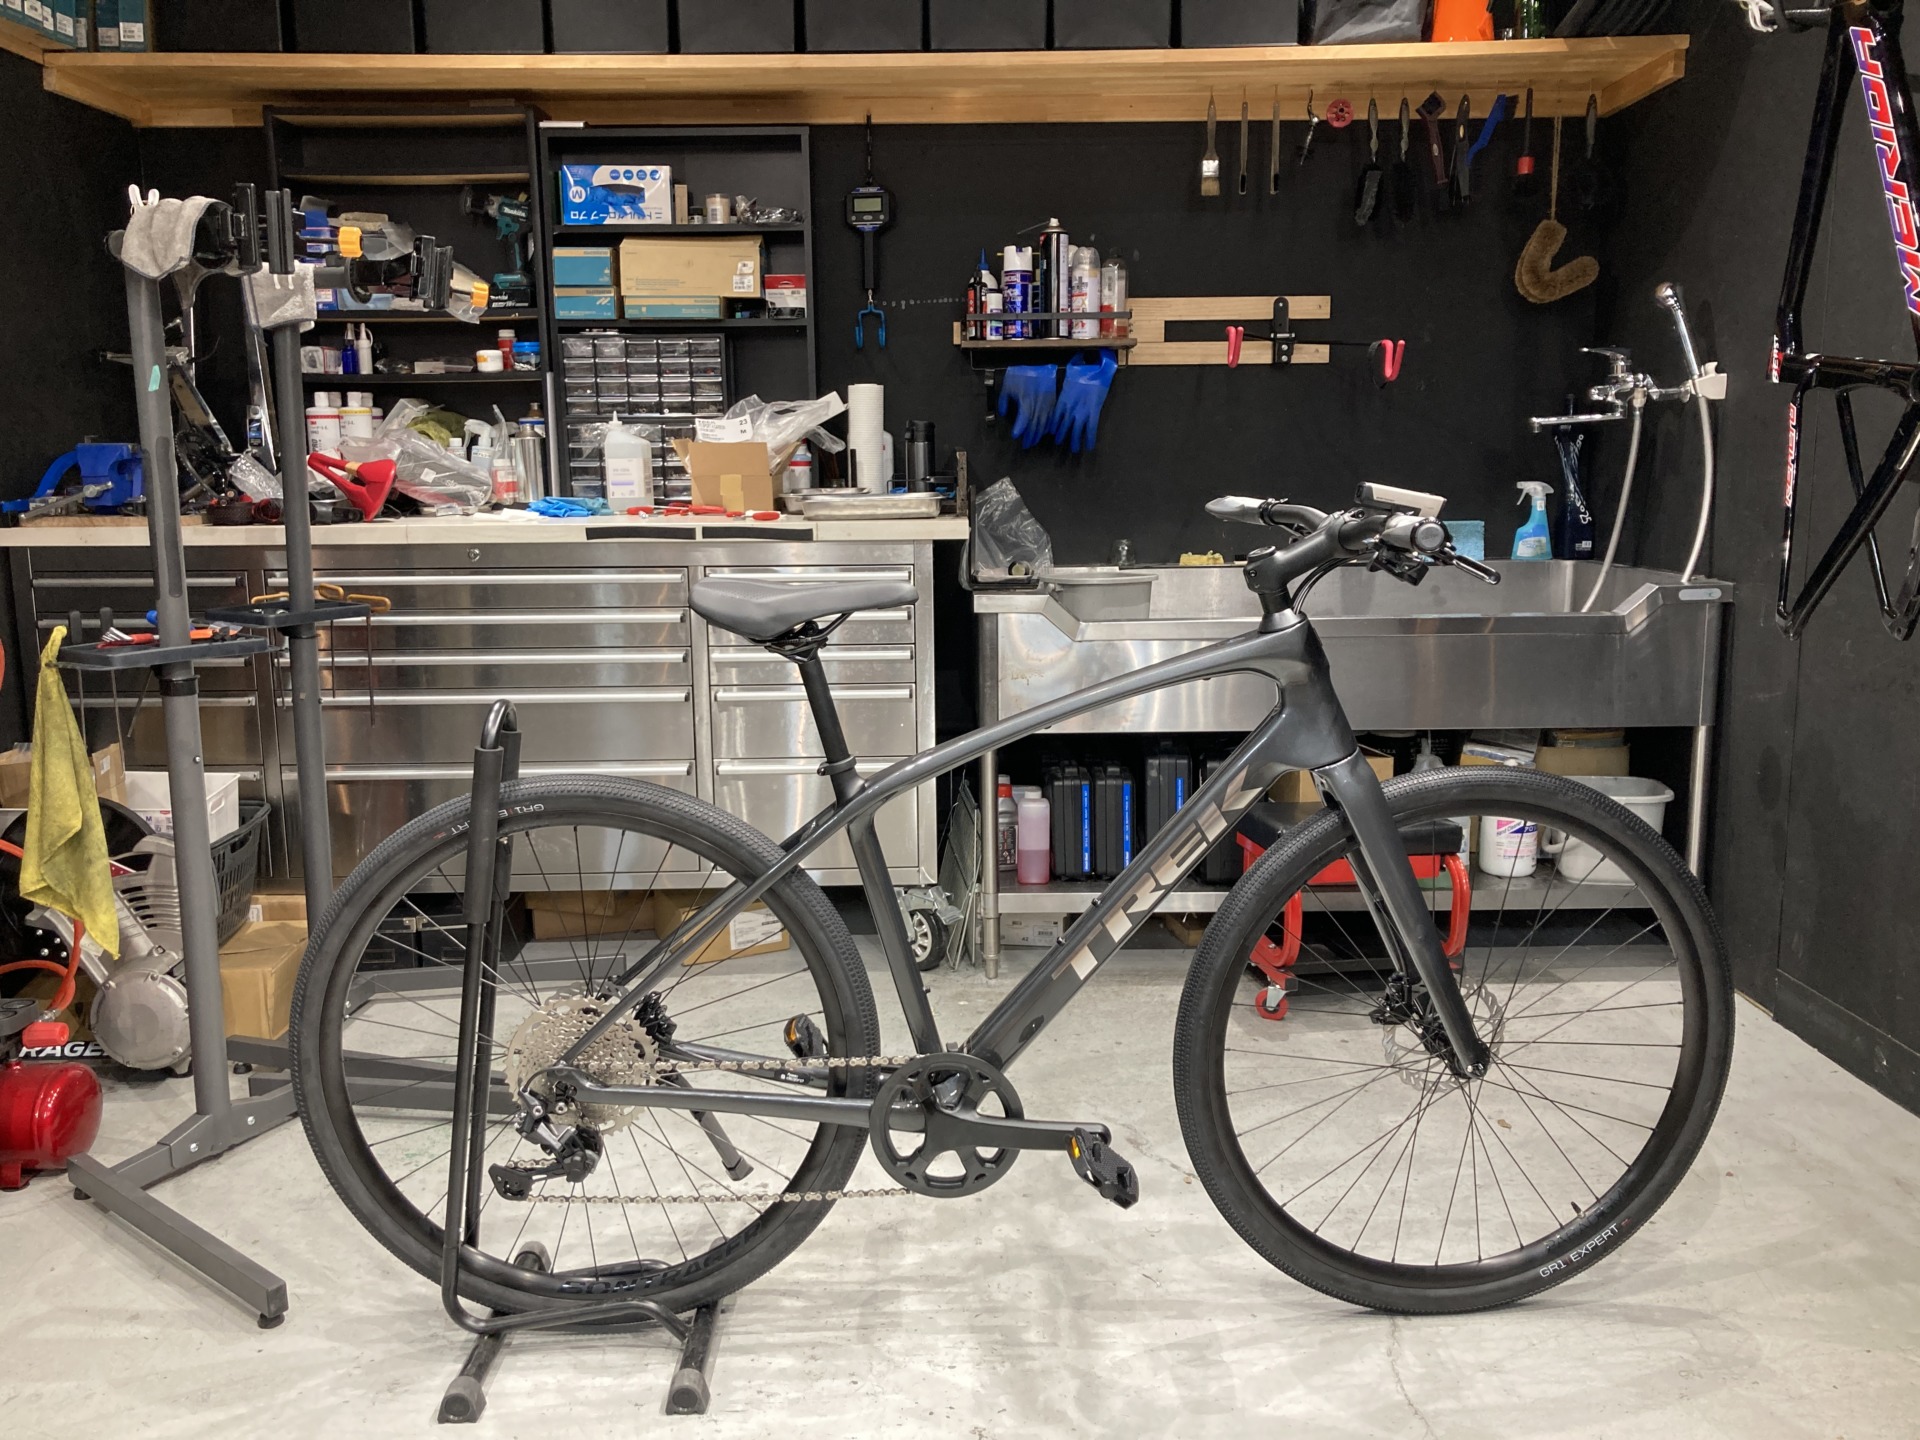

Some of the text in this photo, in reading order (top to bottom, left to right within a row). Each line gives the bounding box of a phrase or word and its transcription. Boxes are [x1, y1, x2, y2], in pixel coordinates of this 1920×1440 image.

[1849, 26, 1920, 316] MERIDA
[739, 418, 748, 426] 23
[514, 803, 545, 815] GR1
[1051, 764, 1263, 981] TREK
[557, 1219, 763, 1294] BONTRAGER
[1540, 1223, 1619, 1278] GR1 EXPERT
